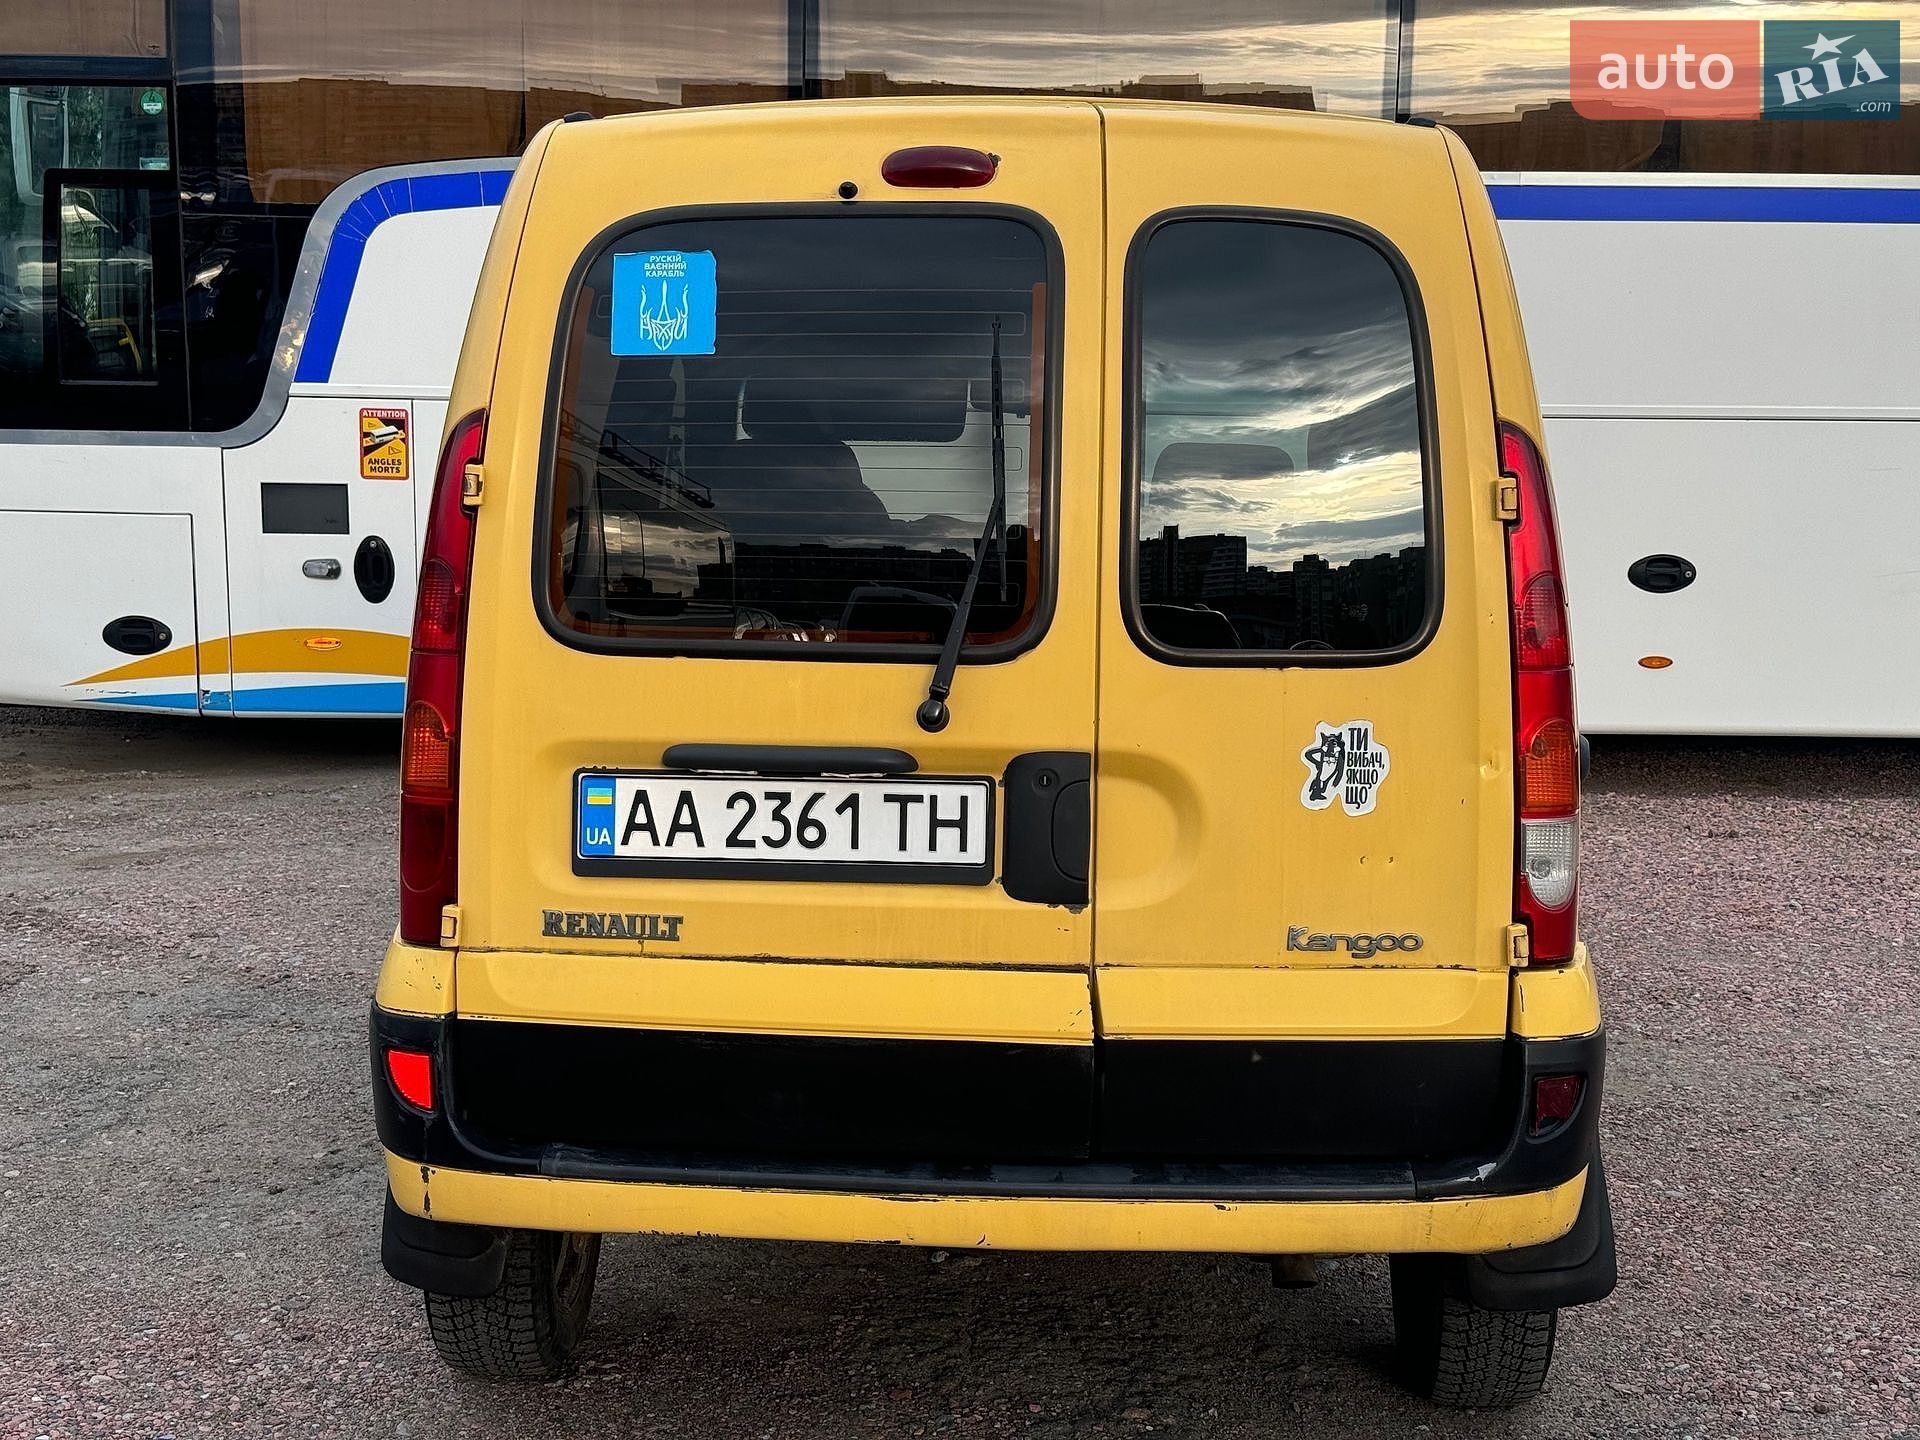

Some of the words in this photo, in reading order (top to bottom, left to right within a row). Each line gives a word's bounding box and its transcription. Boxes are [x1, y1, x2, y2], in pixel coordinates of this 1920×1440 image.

[644, 261, 687, 270] ВАЄННИЙ
[650, 254, 682, 262] РУСКІЙ
[362, 410, 406, 418] ATTENTION
[1348, 727, 1368, 751] ТИ
[1346, 751, 1385, 769] ВИБАЧ,
[1345, 768, 1379, 789] ЯКЩО
[1345, 786, 1368, 809] ЩО
[620, 788, 705, 848] AA
[725, 790, 860, 850] 2361
[883, 793, 968, 853] TH
[586, 827, 612, 846] UA
[542, 909, 684, 941] RENAULT
[1286, 925, 1424, 959] Kangoo
